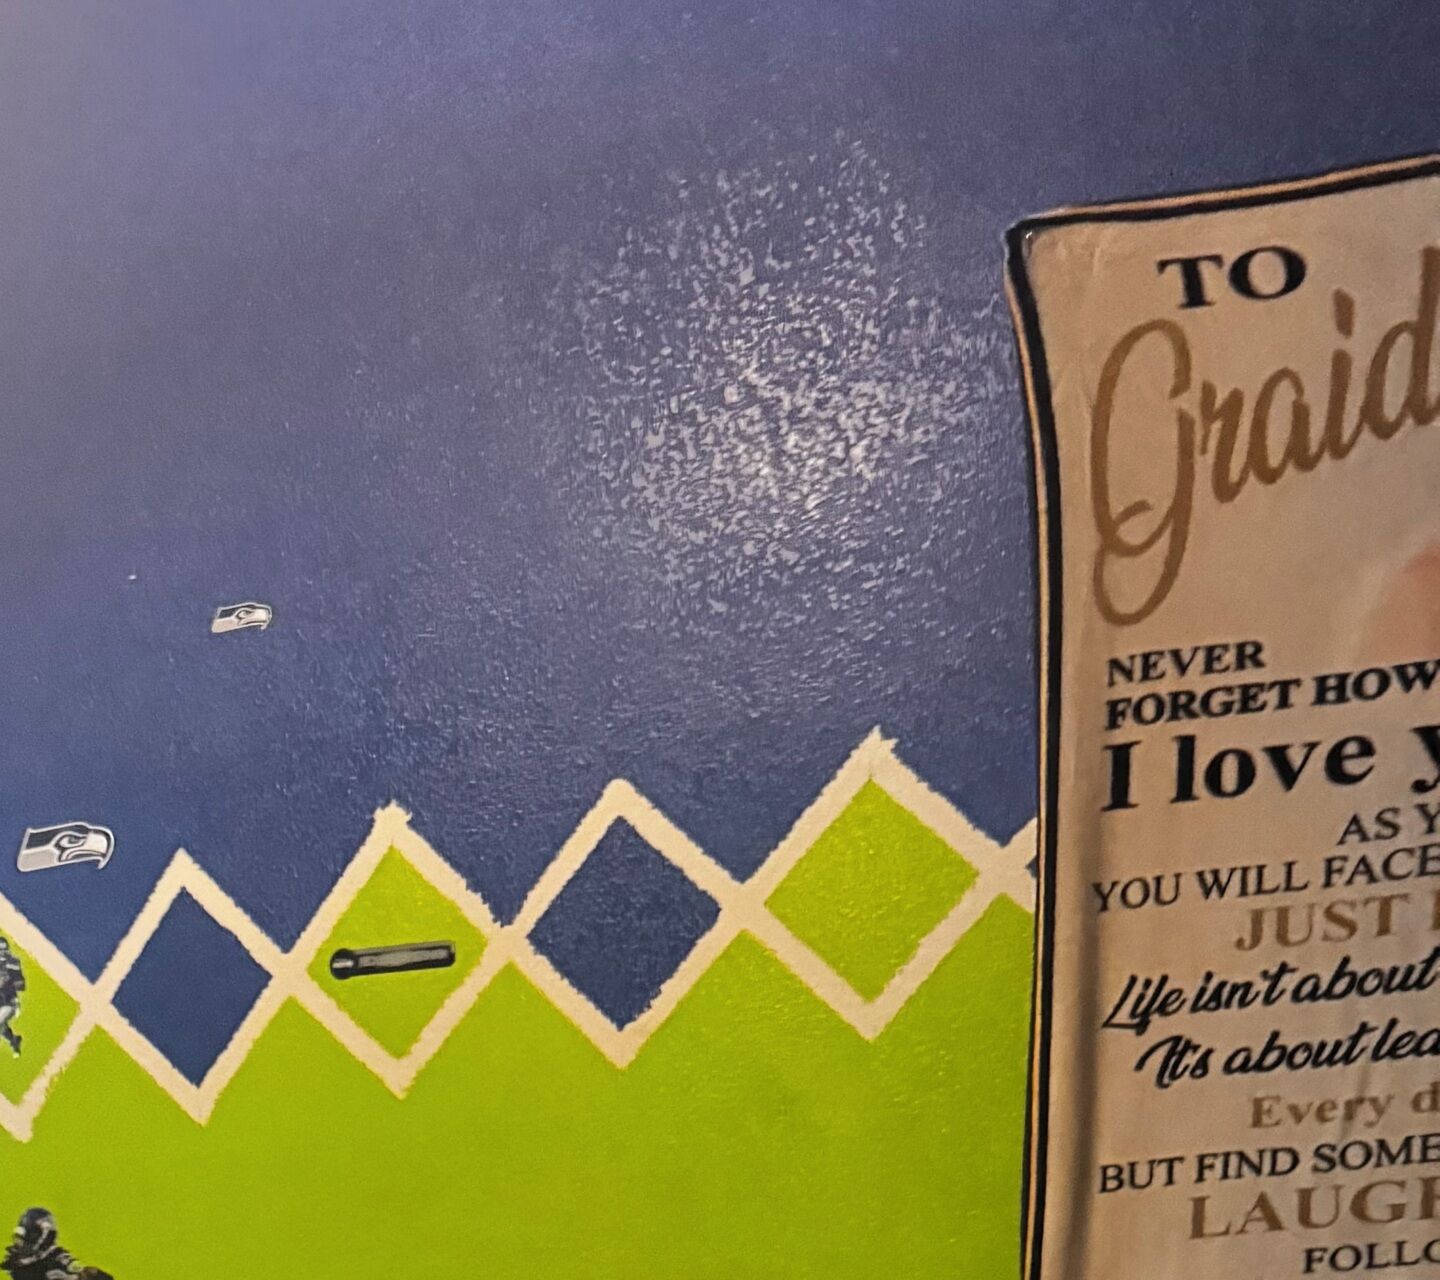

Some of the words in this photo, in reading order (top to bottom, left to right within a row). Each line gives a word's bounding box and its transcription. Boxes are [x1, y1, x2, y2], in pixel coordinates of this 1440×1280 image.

[1157, 245, 1307, 310] TO
[1105, 678, 1302, 731] FORGET
[1310, 659, 1440, 706] HOW
[1107, 640, 1266, 687] NEVER
[1101, 740, 1142, 812] I
[1170, 734, 1376, 804] love
[1336, 807, 1401, 846] AS
[1092, 873, 1182, 913] YOU
[1195, 861, 1309, 901] WILL
[1320, 843, 1440, 889] FACE
[1234, 893, 1410, 952] JUST
[1101, 974, 1186, 1036] Life
[1189, 960, 1299, 1014] isn't
[1290, 946, 1440, 1004] about
[1222, 1021, 1379, 1076] about
[1250, 1094, 1395, 1129] Every
[1099, 1156, 1184, 1194] BUT
[1193, 1146, 1300, 1184] FIND
[1311, 1131, 1440, 1174] SOME
